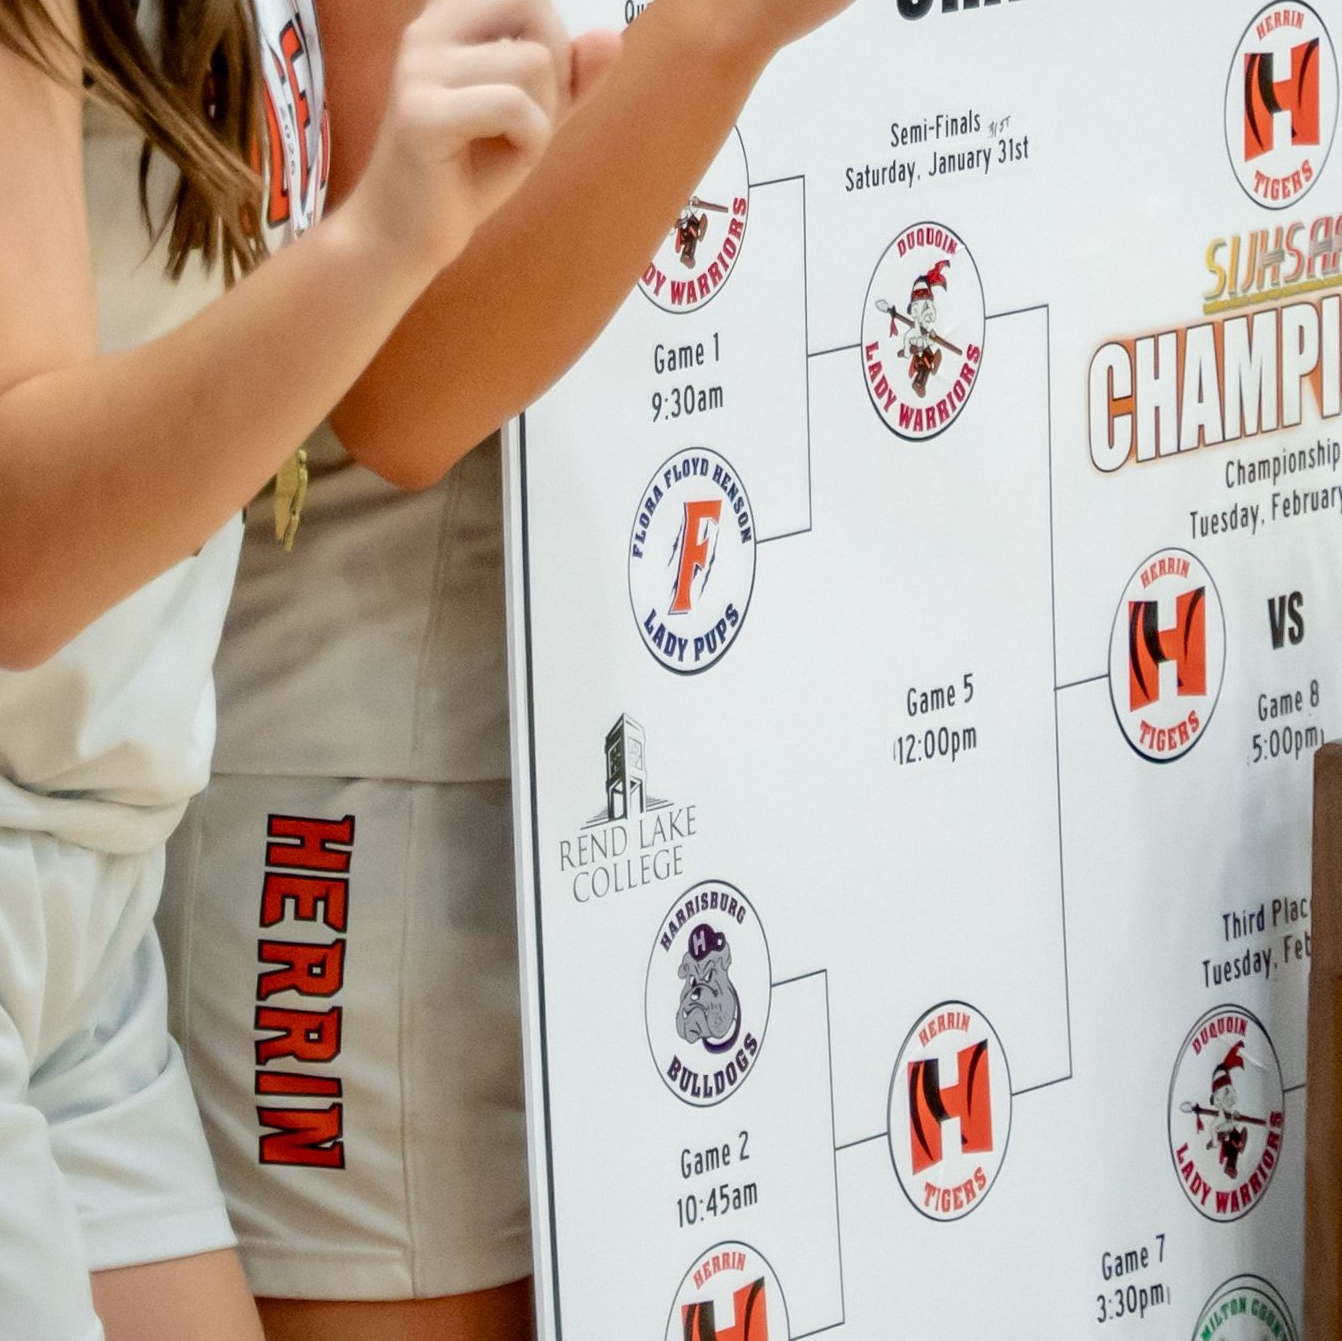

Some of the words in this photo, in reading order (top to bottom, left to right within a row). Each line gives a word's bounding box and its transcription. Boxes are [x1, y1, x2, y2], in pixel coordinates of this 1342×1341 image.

[1255, 8, 1306, 42] HERRIN
[1244, 36, 1320, 163] H
[890, 109, 982, 148] Semi-Finals
[845, 153, 922, 193] Saturday,
[928, 146, 992, 180] January
[997, 136, 1030, 165] 31st
[1254, 158, 1314, 202] TIGERS
[639, 260, 667, 297] DY
[671, 197, 747, 305] WARRIORS
[896, 226, 959, 258] DUQUOIN
[653, 337, 706, 376] Game
[714, 332, 721, 362] 1
[651, 380, 725, 423] 9:30am
[865, 341, 897, 414] LADY
[899, 343, 981, 433] WARRIORS
[1225, 438, 1342, 490] Championship
[632, 484, 664, 559] FLORA
[664, 457, 710, 490] FLOYD
[711, 464, 754, 545] HENSON
[1190, 505, 1266, 540] Tuesday,
[668, 499, 723, 615] F
[1140, 556, 1190, 589] HERRIN
[643, 608, 690, 662] LADY
[693, 602, 740, 662] PUPS
[1267, 591, 1305, 650] VS
[1128, 586, 1206, 712] H
[906, 687, 956, 718] Game
[963, 673, 975, 704] 5
[1257, 690, 1304, 722] Game
[1310, 680, 1320, 706] 8
[896, 723, 978, 765] 12:00pm
[1140, 709, 1200, 752] TIGERS
[1252, 728, 1319, 765] 5:00pm
[559, 824, 629, 872] REND
[638, 804, 698, 852] LAKE
[572, 846, 685, 904] COLLEGE
[660, 890, 747, 953] HARRISBURG
[1222, 905, 1266, 943] Third
[1272, 897, 1310, 929] Plac
[254, 813, 356, 1170] HERRIN
[1202, 951, 1279, 989] Tuesday,
[919, 1011, 971, 1047] HERRIN
[1192, 1017, 1247, 1055] DUQUOIN
[666, 1031, 759, 1100] BULLDOGS
[907, 1038, 994, 1175] H
[680, 1146, 731, 1180] Game
[738, 1130, 751, 1162] 2
[1175, 1142, 1211, 1207] LADY
[1216, 1110, 1284, 1215] WARRIORS
[676, 1181, 759, 1228] 10:45am
[924, 1166, 987, 1213] TIGERS
[693, 1251, 747, 1290] HERRIN
[1101, 1245, 1150, 1281] Game
[1157, 1232, 1167, 1264] 7
[1096, 1285, 1165, 1324] 3:30pm
[1200, 1296, 1247, 1341] MILTON
